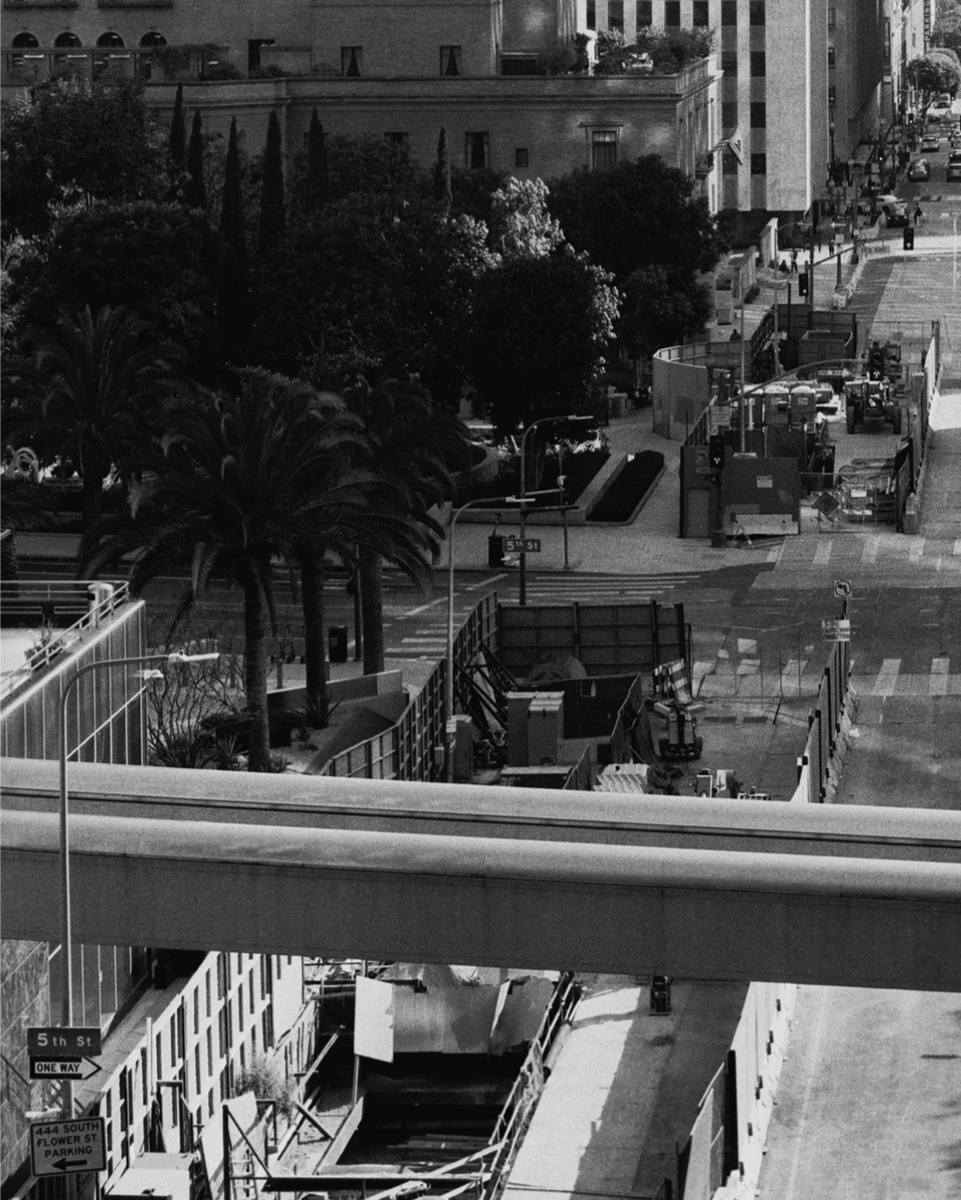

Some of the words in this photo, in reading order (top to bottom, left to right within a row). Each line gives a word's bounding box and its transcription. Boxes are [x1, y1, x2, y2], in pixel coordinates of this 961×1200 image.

[507, 541, 523, 550] 5th
[527, 541, 538, 550] St
[37, 1033, 67, 1047] 5th
[76, 1036, 91, 1047] St
[36, 1063, 57, 1072] ONE
[59, 1063, 80, 1072] WAY
[35, 1125, 59, 1135] 444
[63, 1122, 99, 1134] SOUTH
[37, 1135, 81, 1147] FLOWER
[84, 1133, 99, 1143] ST.
[44, 1145, 93, 1158] PARKING
